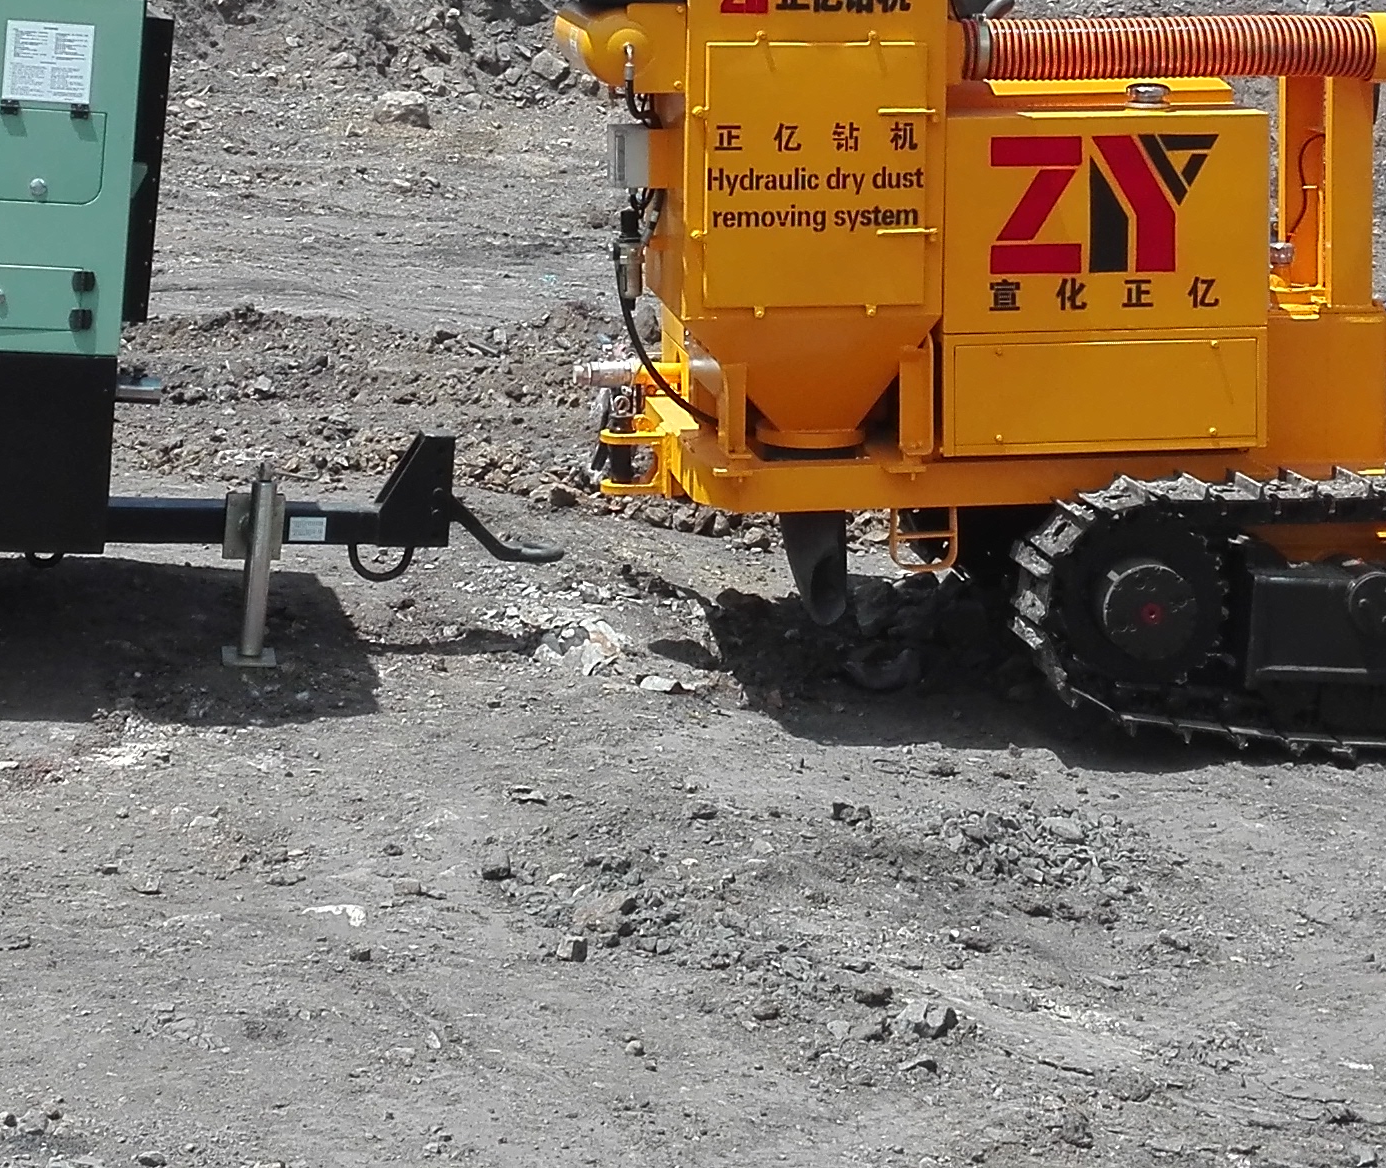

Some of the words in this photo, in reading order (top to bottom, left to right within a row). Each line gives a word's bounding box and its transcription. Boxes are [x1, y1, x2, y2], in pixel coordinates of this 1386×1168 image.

[714, 122, 918, 152] 正亿钻机
[708, 167, 819, 196] Hydraulic
[826, 167, 865, 195] dry
[872, 166, 924, 189] dust
[713, 204, 826, 232] removing
[834, 205, 918, 231] system
[989, 276, 1220, 311] 宣化正亿
